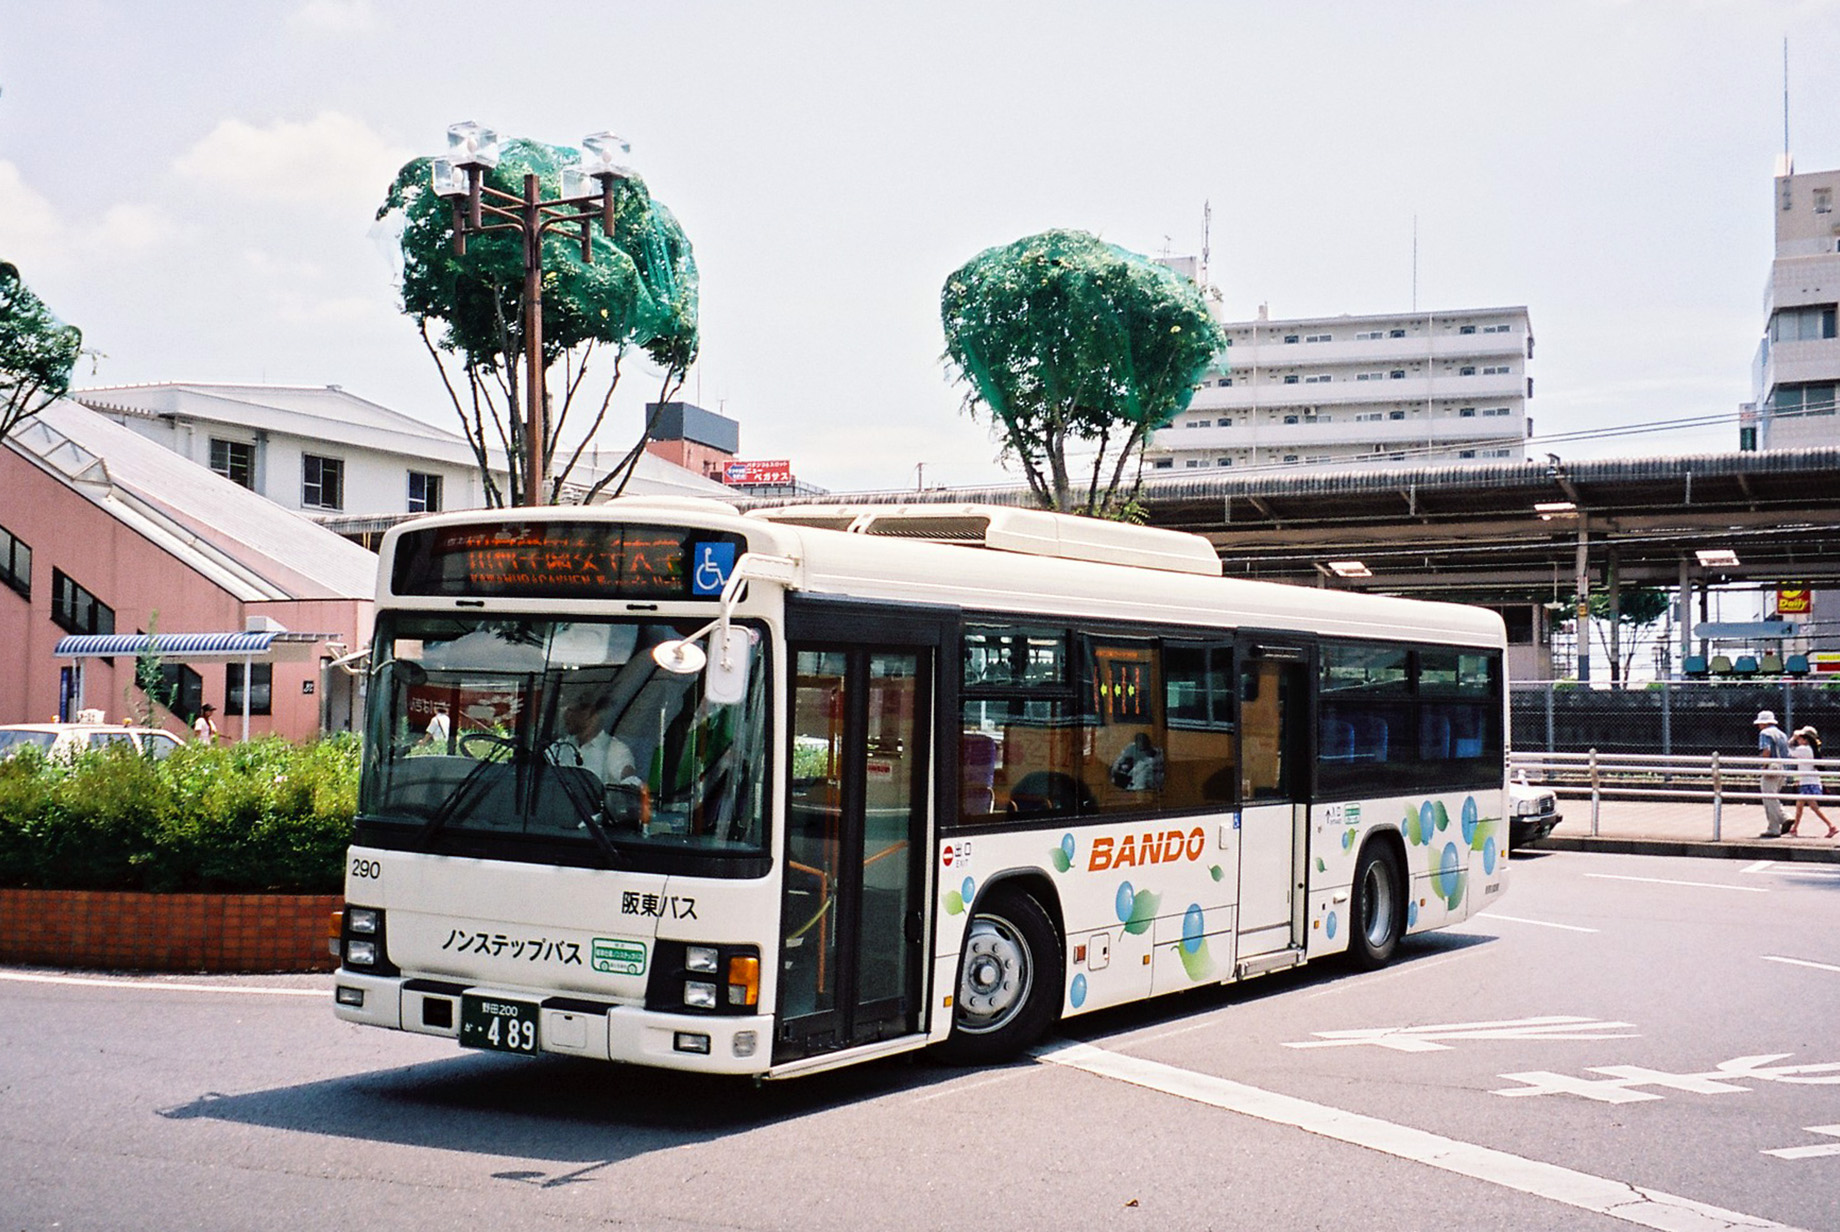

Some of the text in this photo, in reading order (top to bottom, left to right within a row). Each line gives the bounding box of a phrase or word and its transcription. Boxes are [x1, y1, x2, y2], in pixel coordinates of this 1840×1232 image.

[1778, 598, 1807, 610] Daily
[1088, 826, 1205, 872] BANDO
[352, 858, 381, 880] 290
[621, 891, 698, 920] 阪東バス
[441, 929, 583, 966] ノンステップバス
